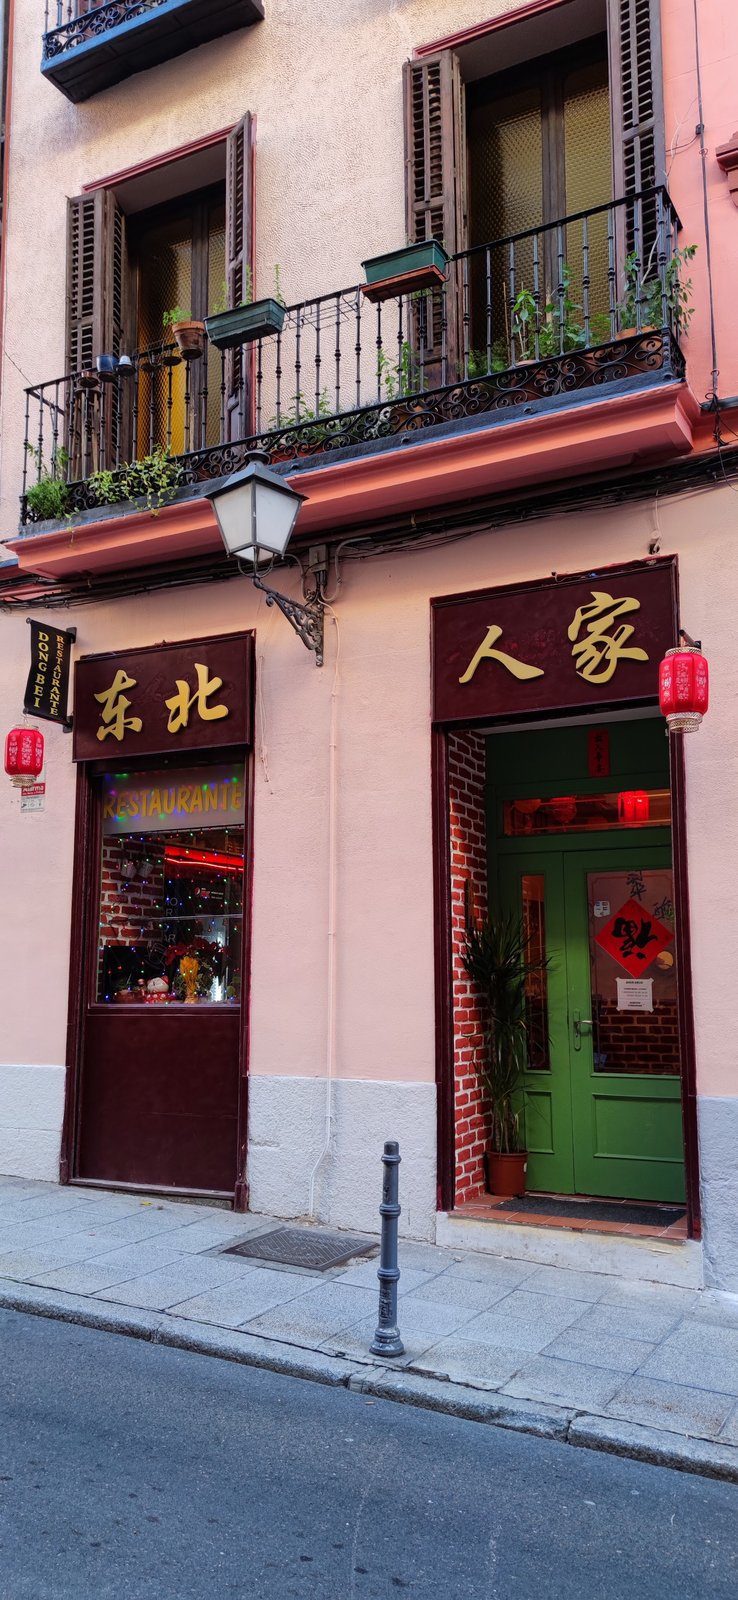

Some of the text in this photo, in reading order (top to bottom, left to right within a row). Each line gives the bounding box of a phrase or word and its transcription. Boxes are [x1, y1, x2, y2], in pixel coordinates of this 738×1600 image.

[33, 631, 50, 708] DONG BEI
[49, 635, 65, 716] RESTAURANTE
[458, 591, 649, 684] 人家
[94, 662, 229, 741] 东北
[103, 782, 243, 819] RESTAURANTE
[611, 917, 658, 960] 福
